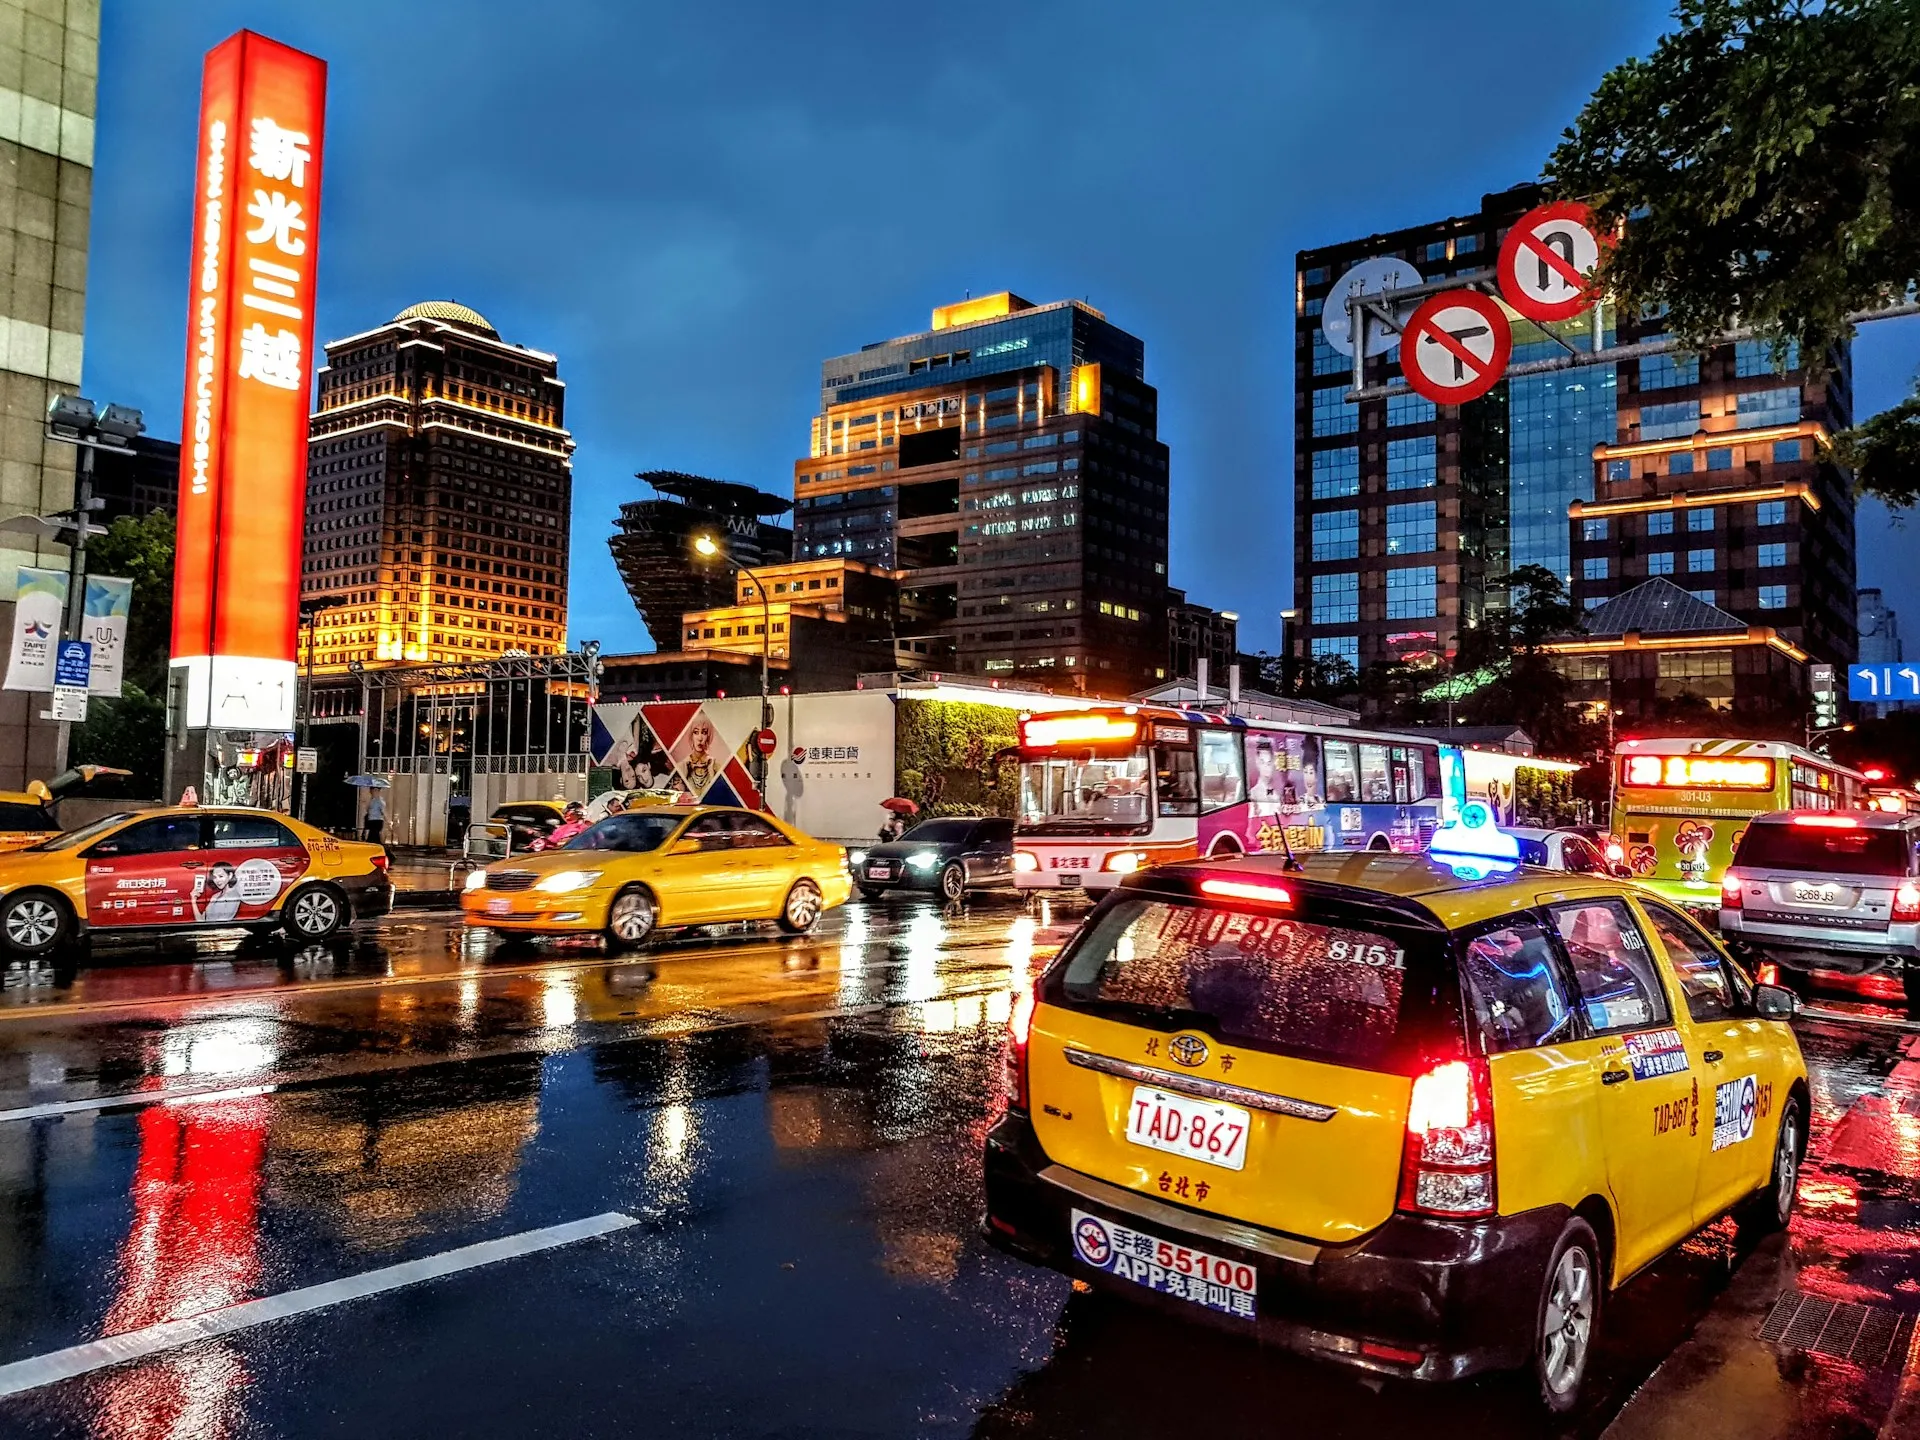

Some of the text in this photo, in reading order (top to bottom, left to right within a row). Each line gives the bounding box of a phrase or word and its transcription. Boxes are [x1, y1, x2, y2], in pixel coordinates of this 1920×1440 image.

[239, 116, 310, 391] 新光三越
[191, 119, 226, 495] SHIN KONG MITSUKOSHI
[23, 641, 47, 650] TAIPEI
[808, 746, 859, 760] 遠東百貨
[1680, 791, 1712, 802] 301-U3
[1327, 940, 1408, 970] 8151
[1620, 929, 1645, 950] 8151
[1145, 1037, 1237, 1074] 北 市
[1755, 1081, 1772, 1119] 8151
[1653, 1097, 1689, 1137] TAD-867
[1158, 1171, 1212, 1202] 台北市
